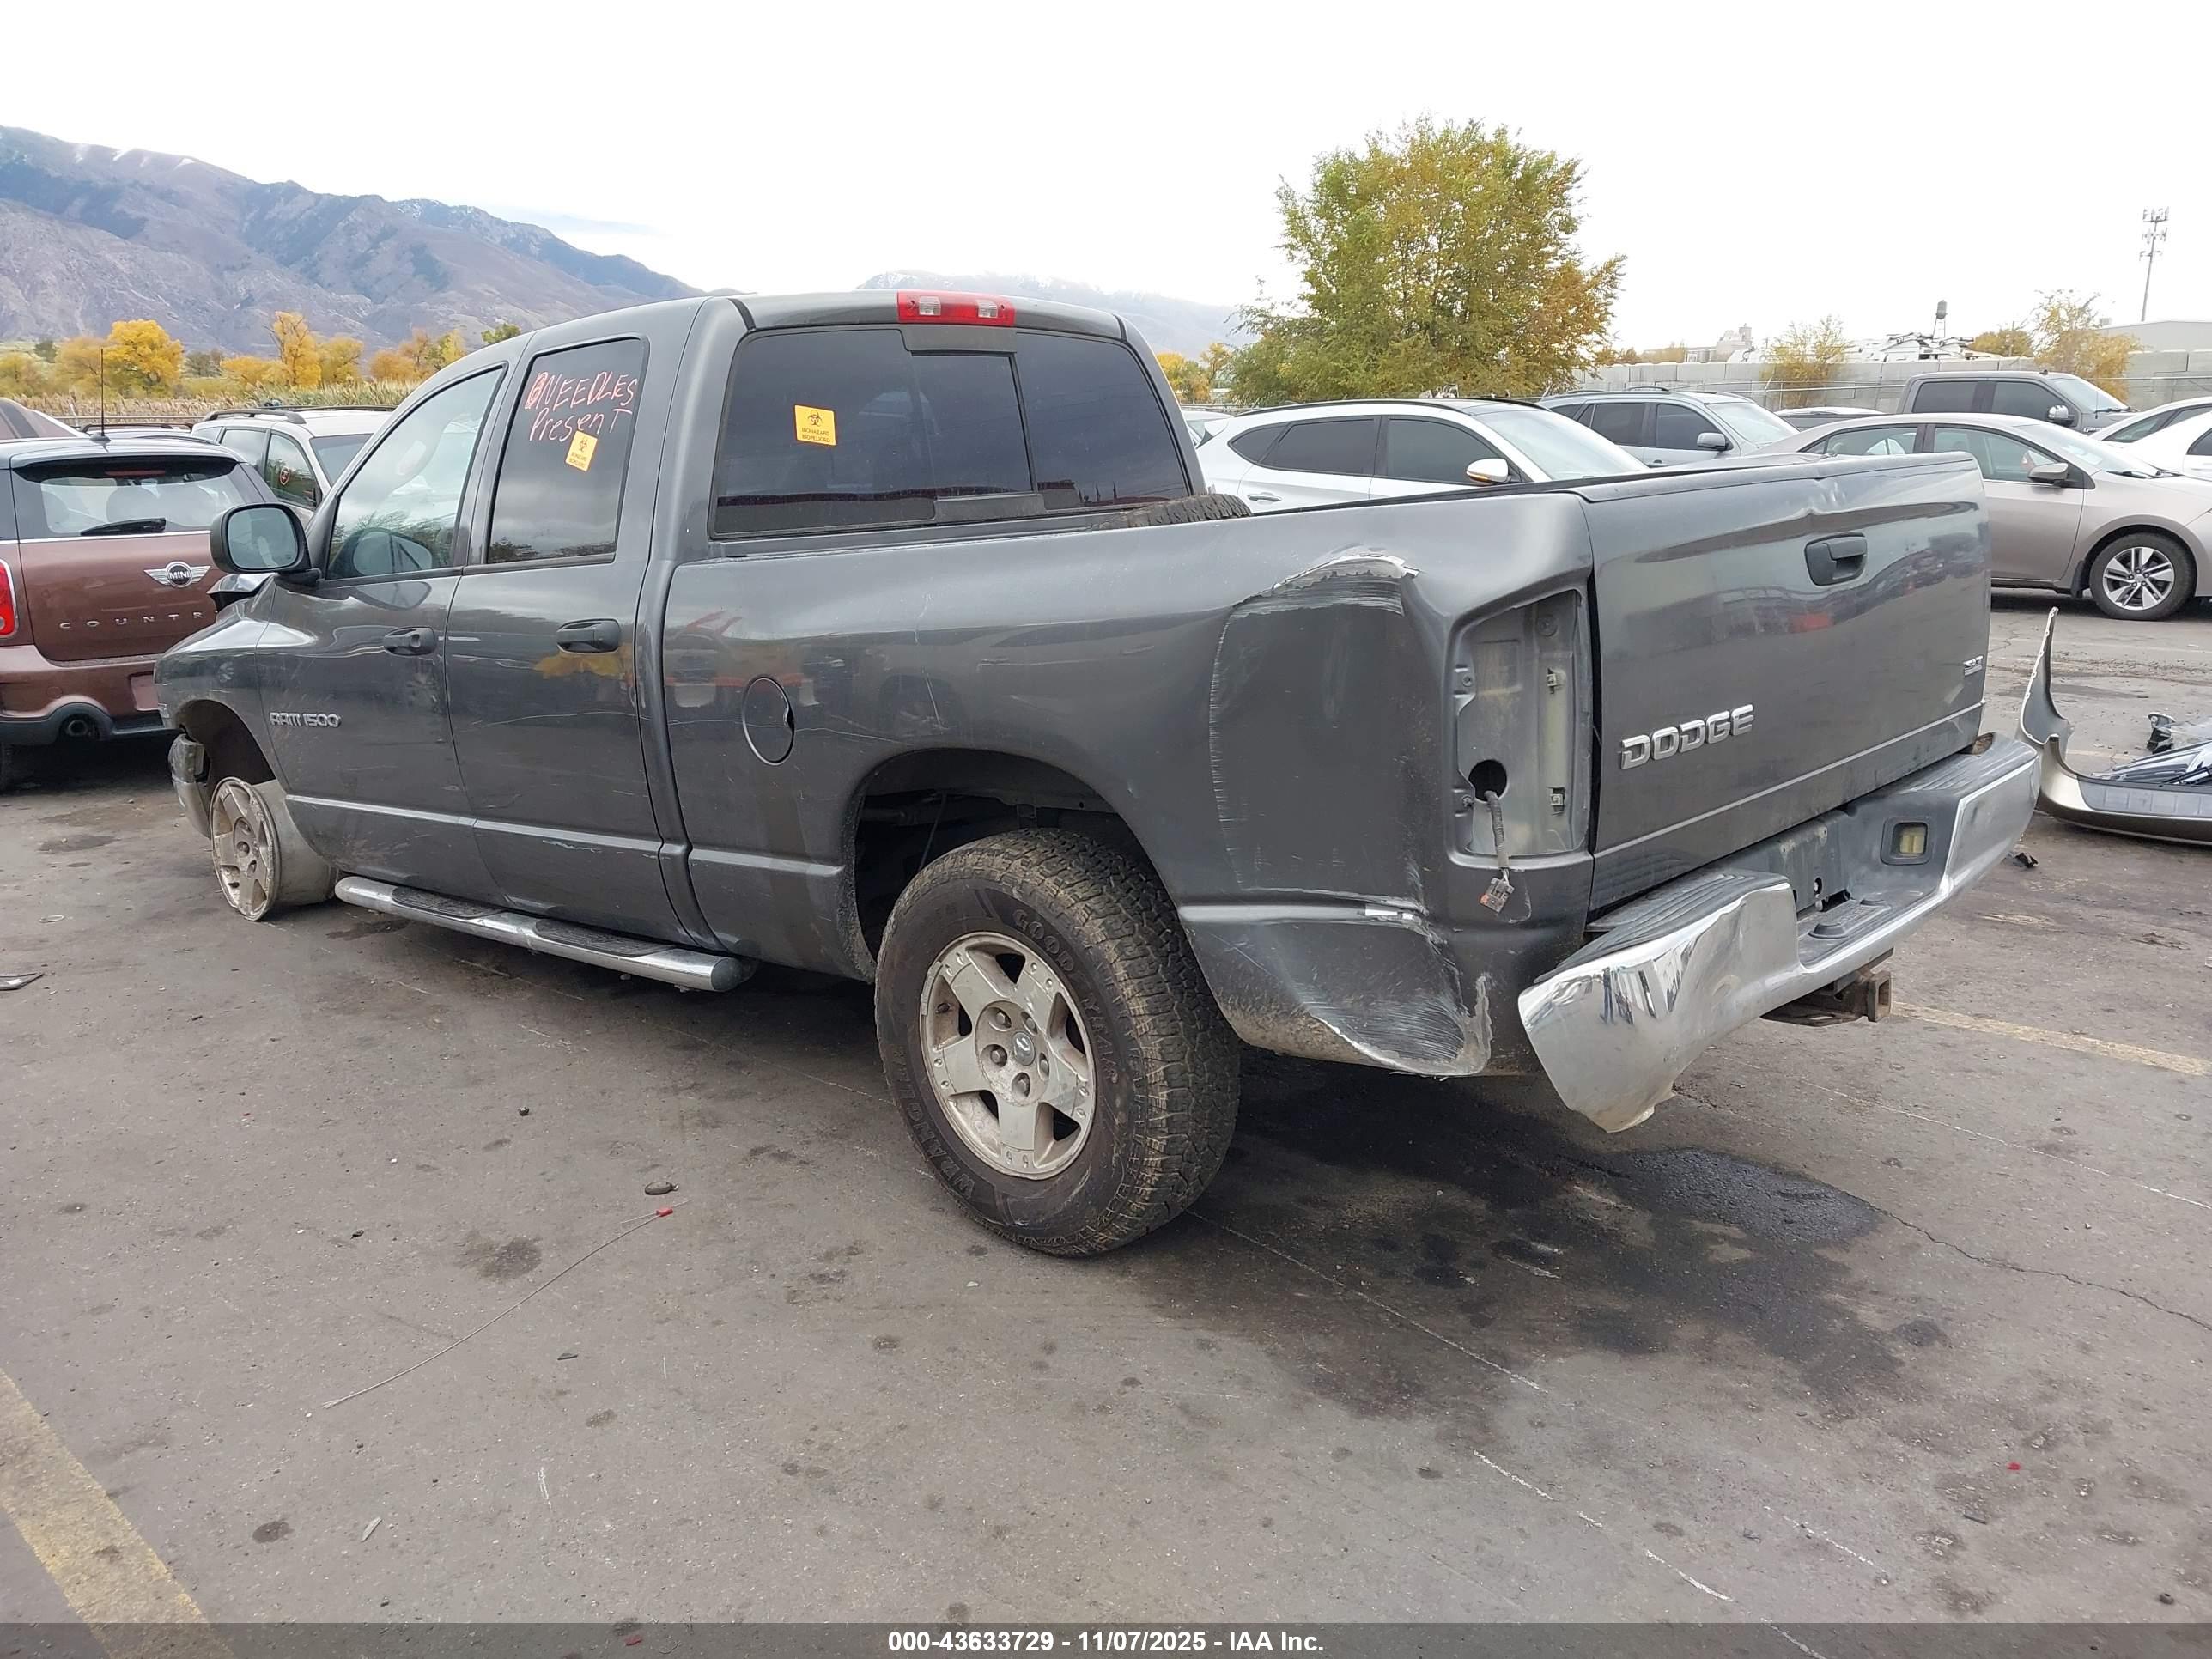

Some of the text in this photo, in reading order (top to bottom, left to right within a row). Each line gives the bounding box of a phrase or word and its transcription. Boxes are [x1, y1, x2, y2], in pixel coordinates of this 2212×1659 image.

[169, 570, 191, 580] MINI
[58, 611, 216, 629] COUNTR
[270, 712, 341, 728] RAM 1500
[1620, 703, 1754, 770] DODGE
